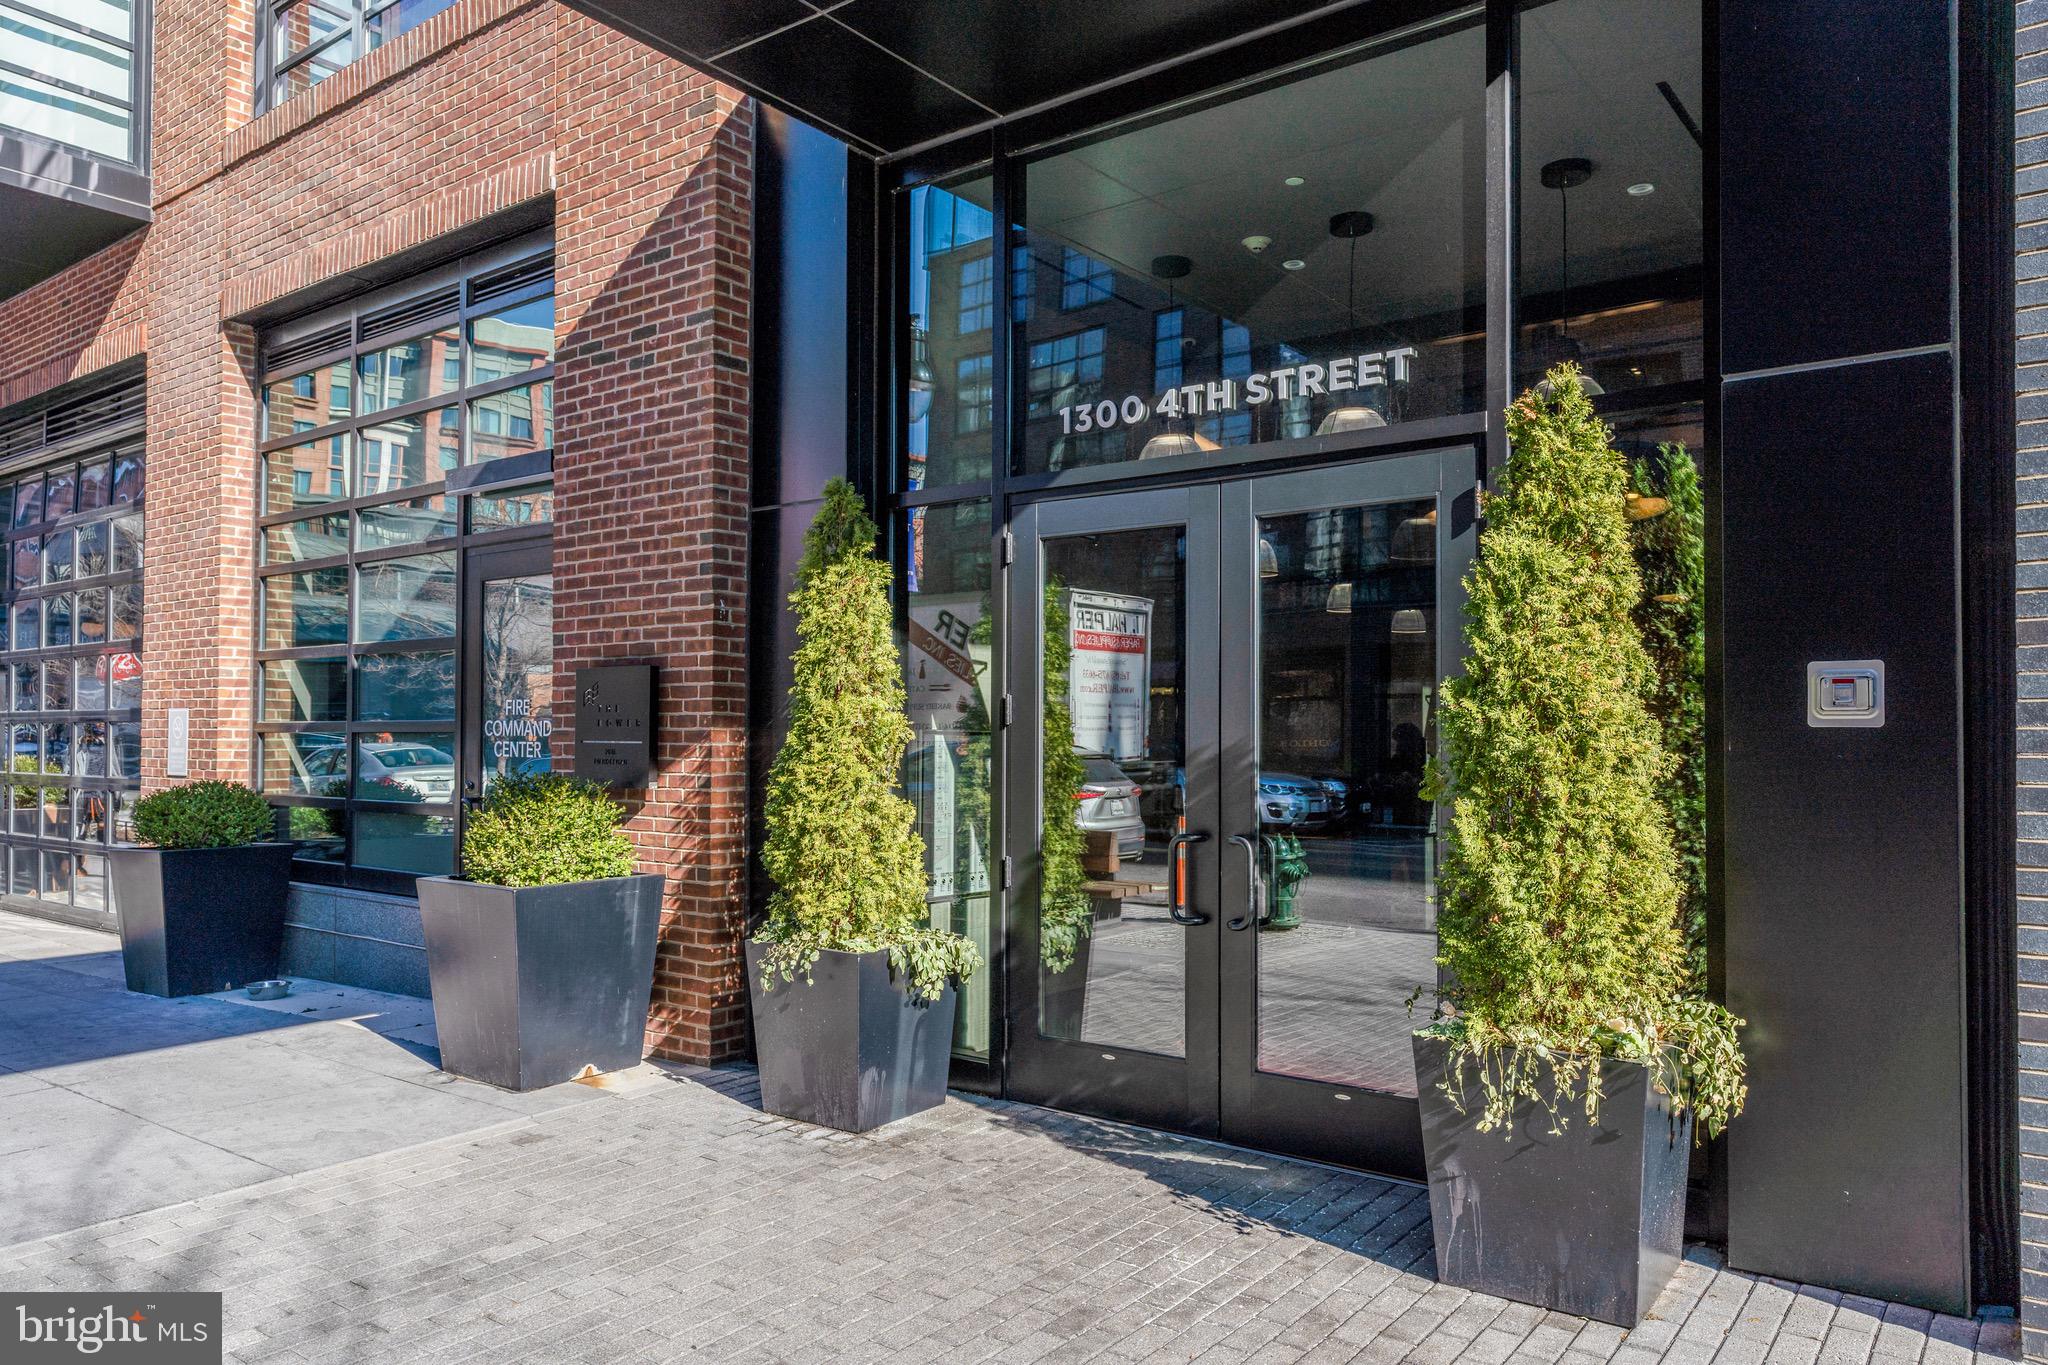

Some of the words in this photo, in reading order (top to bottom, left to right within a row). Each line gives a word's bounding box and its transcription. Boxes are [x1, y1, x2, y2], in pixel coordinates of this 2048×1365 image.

[1059, 395, 1147, 434] 1300
[1156, 379, 1236, 419] 4TH
[1246, 347, 1418, 406] STREET
[505, 699, 530, 716] FIRE
[484, 720, 552, 737] COMMAND
[493, 741, 541, 758] CENTER
